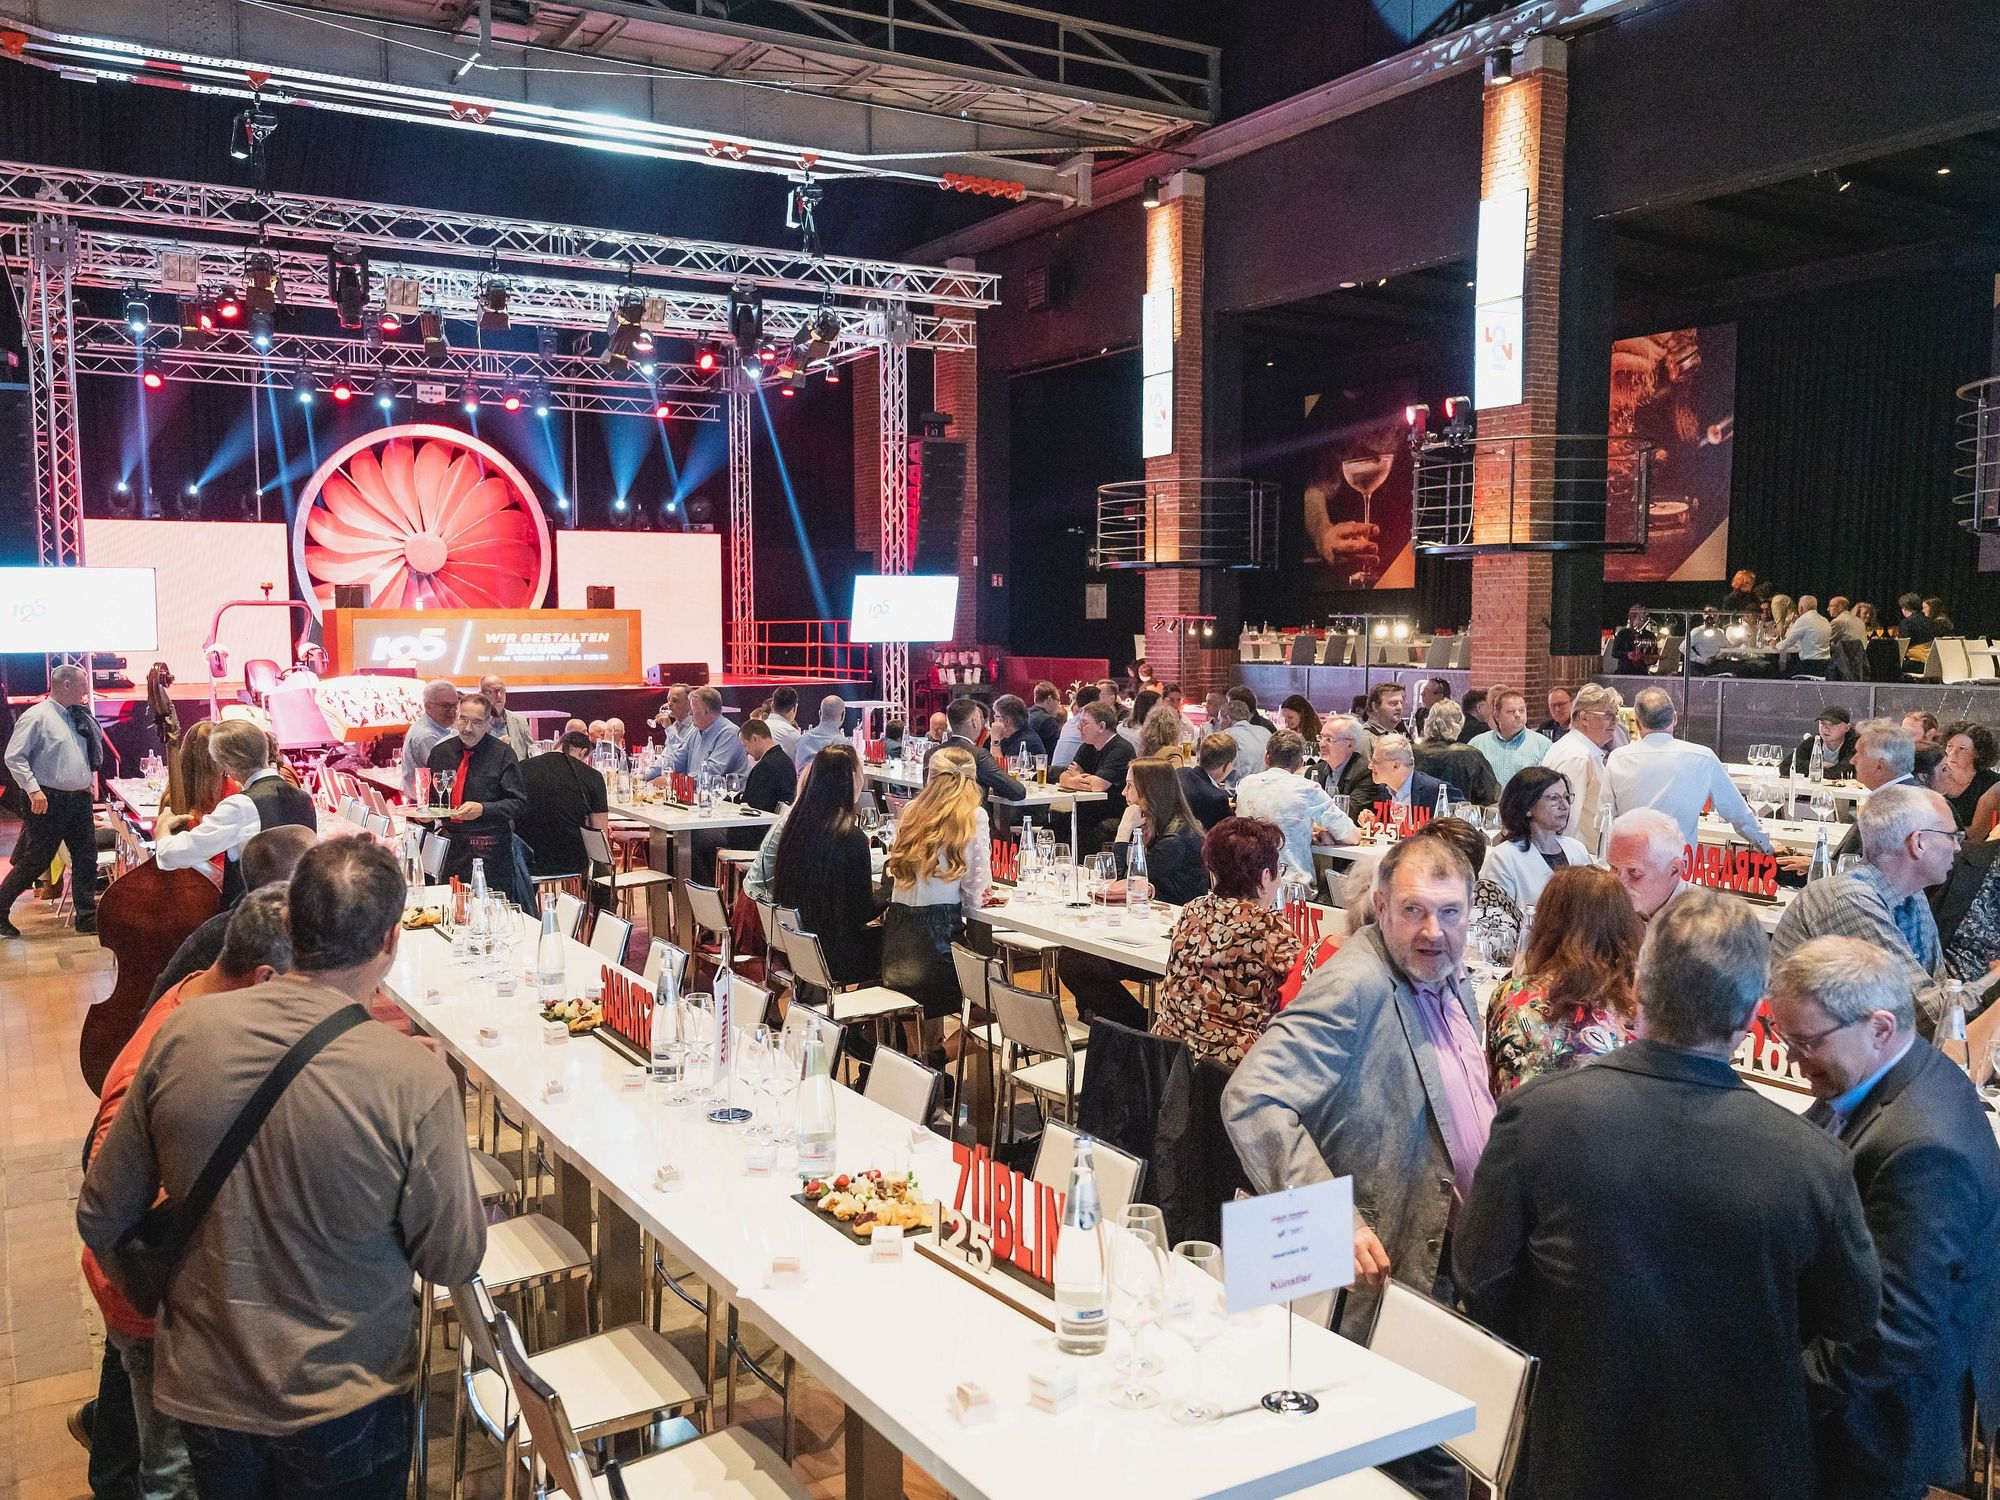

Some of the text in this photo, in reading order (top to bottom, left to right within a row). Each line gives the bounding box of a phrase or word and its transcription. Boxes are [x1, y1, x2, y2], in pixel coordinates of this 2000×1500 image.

[485, 632, 610, 644] WIR GESTALTEN
[1363, 821, 1397, 841] 125
[952, 1141, 1066, 1284] ZÜBLIN
[930, 1199, 994, 1274] 125
[1270, 1273, 1312, 1290] Künstler
